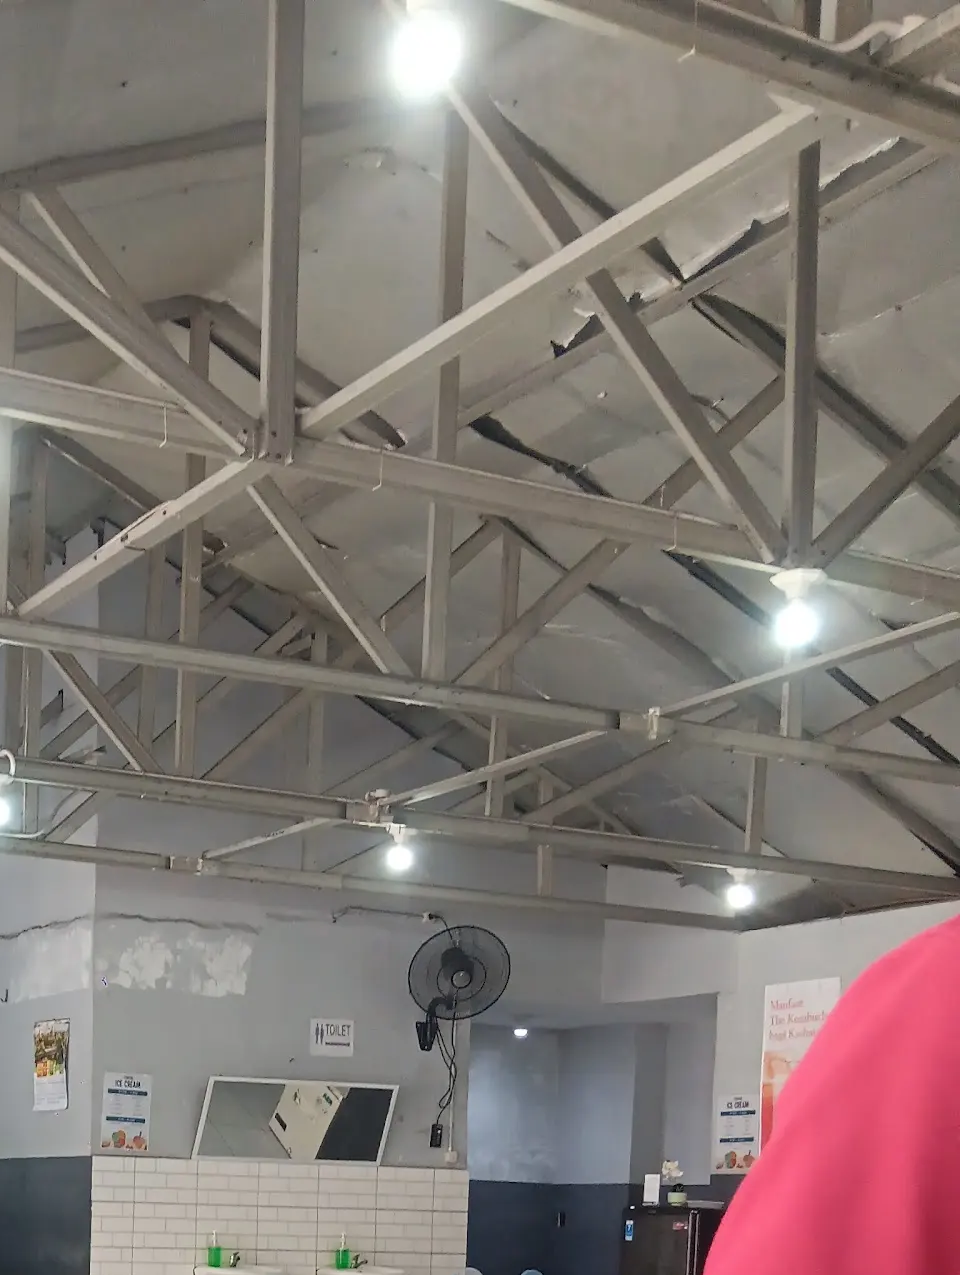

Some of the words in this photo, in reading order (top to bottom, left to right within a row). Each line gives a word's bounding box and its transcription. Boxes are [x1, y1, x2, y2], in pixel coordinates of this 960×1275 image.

[326, 1023, 351, 1036] TOILET
[124, 1079, 141, 1088] CREAM
[734, 1101, 749, 1109] CREAM
